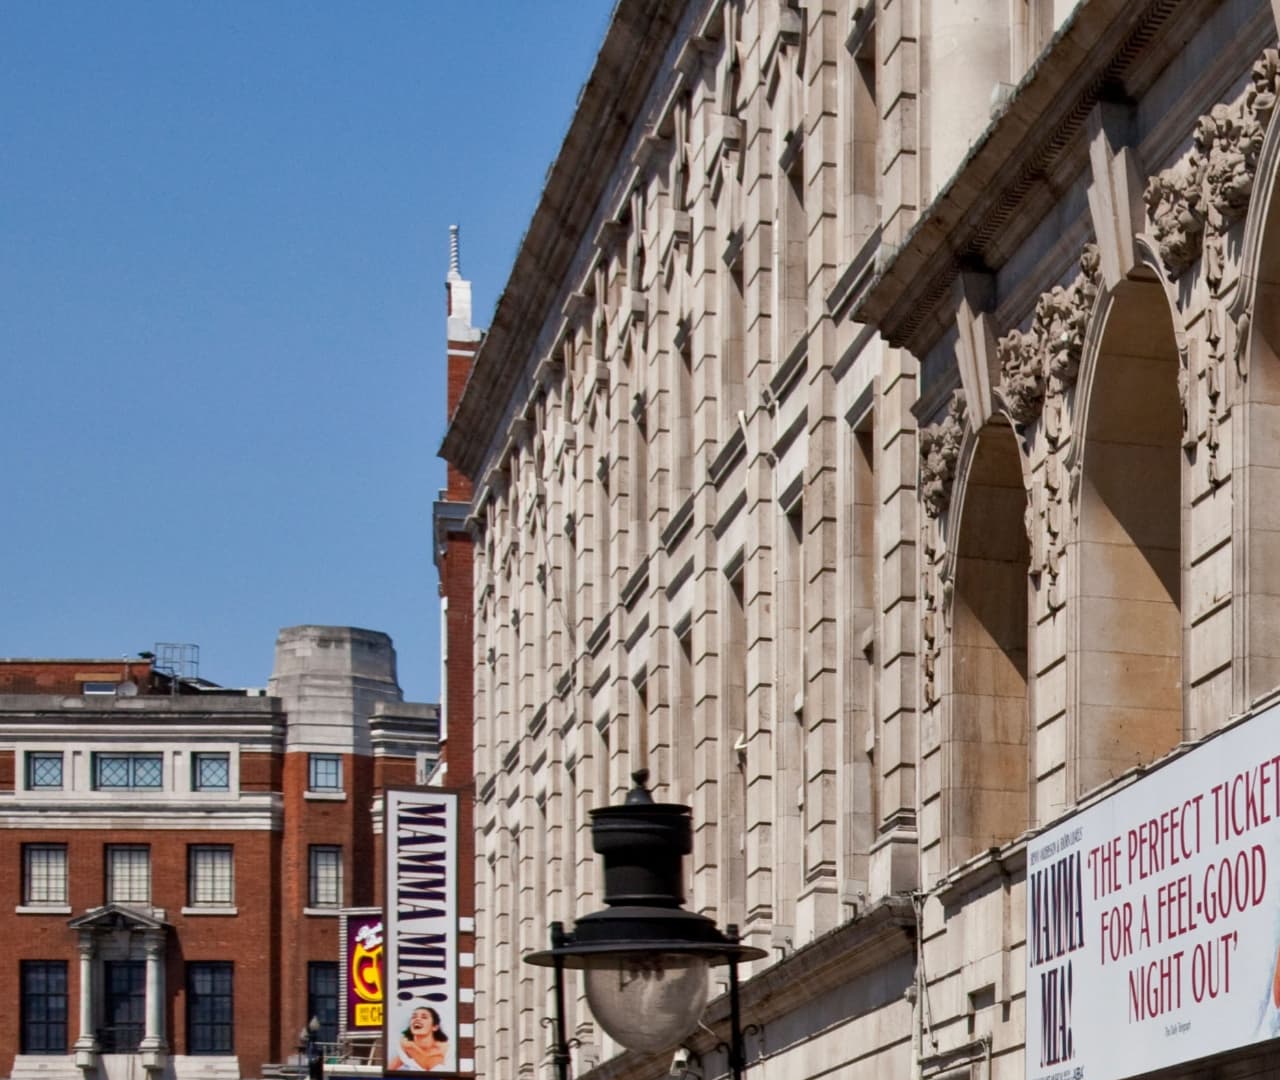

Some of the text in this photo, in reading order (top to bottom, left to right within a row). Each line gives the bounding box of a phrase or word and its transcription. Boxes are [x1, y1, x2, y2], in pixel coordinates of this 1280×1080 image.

[396, 801, 448, 1002] MAMMA MIA!
[1088, 837, 1122, 901] 'THE
[1128, 794, 1203, 884] PERFECT
[1030, 850, 1085, 968] MAMMA
[1101, 901, 1134, 966] FOR
[1139, 894, 1151, 950] A
[1157, 844, 1267, 944] FEEL-GOOD
[1039, 959, 1076, 1069] MIA!
[1128, 929, 1238, 1025] NIGHT OUT'
